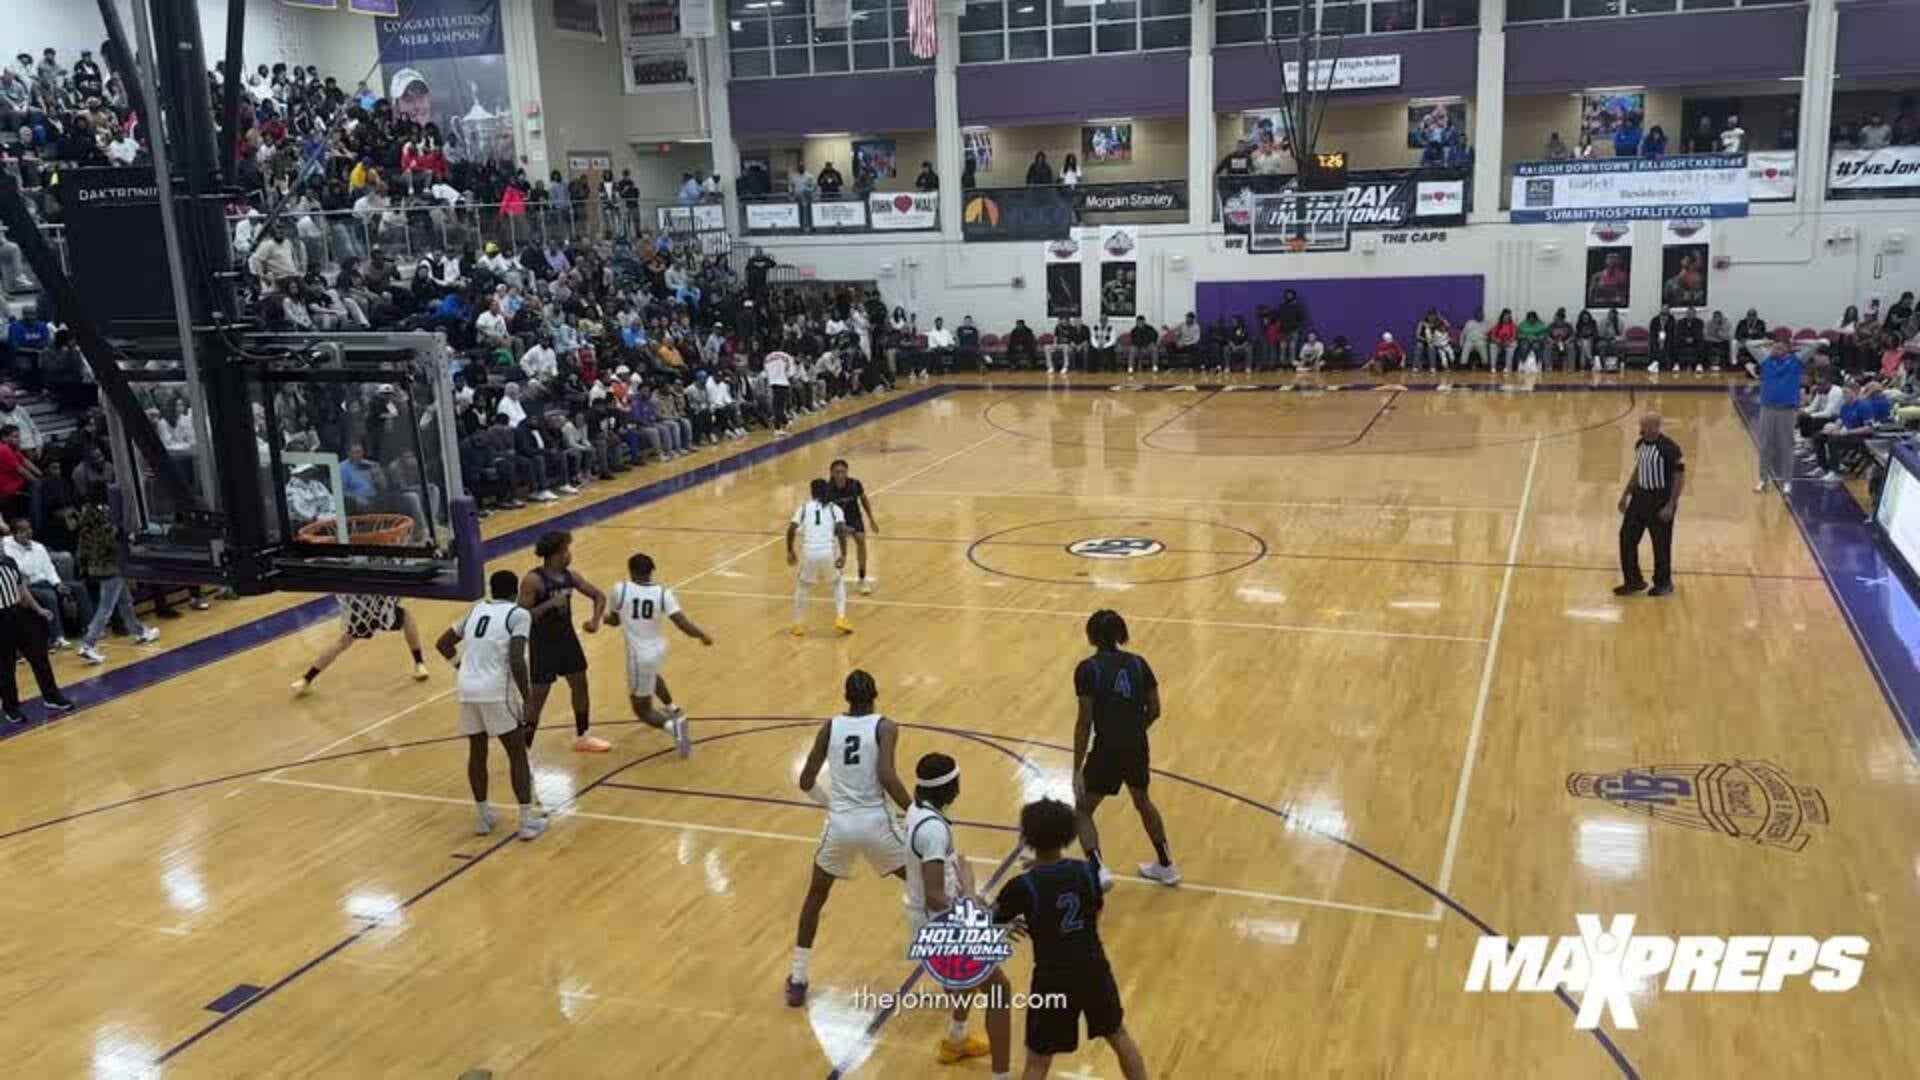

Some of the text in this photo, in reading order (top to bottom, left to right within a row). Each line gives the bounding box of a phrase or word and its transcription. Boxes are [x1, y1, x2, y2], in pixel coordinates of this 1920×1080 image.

[383, 15, 493, 32] CONGRATULATIONS
[431, 29, 480, 44] SIMPSON
[1519, 165, 1563, 175] RALEIGH
[1565, 162, 1630, 173] DOWNTOWN
[1085, 193, 1173, 209] Morgan Stanley
[1545, 205, 1712, 221] SUMMITHOSPITALITY.COM
[1382, 233, 1408, 244] THE
[1410, 231, 1447, 243] CAPS
[814, 509, 822, 525] 1
[631, 599, 654, 619] 10
[474, 615, 491, 638] 0
[1114, 668, 1131, 698] 4
[843, 735, 861, 765] 2
[1056, 891, 1084, 933] 2
